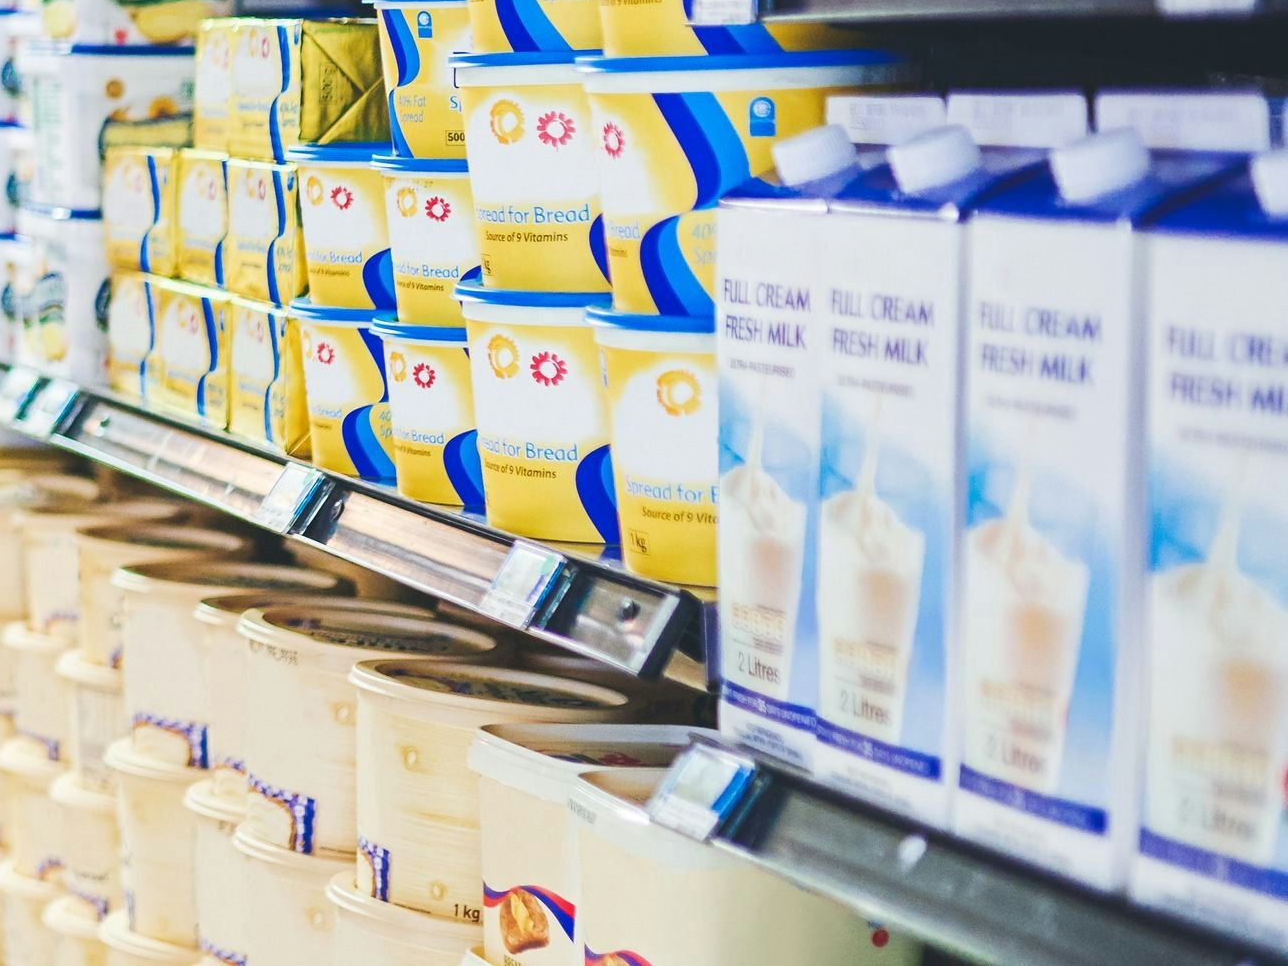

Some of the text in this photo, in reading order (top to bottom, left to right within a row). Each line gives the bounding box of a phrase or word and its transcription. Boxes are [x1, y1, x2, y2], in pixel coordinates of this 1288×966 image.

[508, 206, 529, 224] for
[533, 203, 590, 224] Bread
[485, 231, 569, 243] Source of 9 Vitamins
[329, 250, 363, 264] Bread
[422, 264, 460, 278] Bread
[416, 281, 445, 292] Vitamins
[724, 278, 812, 313] FULL CREAM
[830, 288, 935, 328] FULL CREAM
[979, 300, 1104, 344] FULL CREAM
[724, 314, 808, 351] FRESH MILK
[1166, 323, 1215, 361] FULL
[832, 327, 929, 368] FRESH MILK
[981, 341, 1096, 386] FRESH MILK
[1170, 370, 1243, 408] FRESH
[411, 430, 445, 445] Bread
[524, 442, 579, 462] Bread
[500, 463, 508, 474] of
[515, 465, 558, 479] Vitamins
[625, 479, 673, 501] Spread
[676, 483, 704, 503] for
[641, 505, 719, 524] Source of 9 Vita
[737, 651, 782, 685] 2 Litres
[839, 688, 893, 726] 2 Litres
[1001, 738, 1045, 775] Litres
[453, 903, 481, 922] 1 kg
